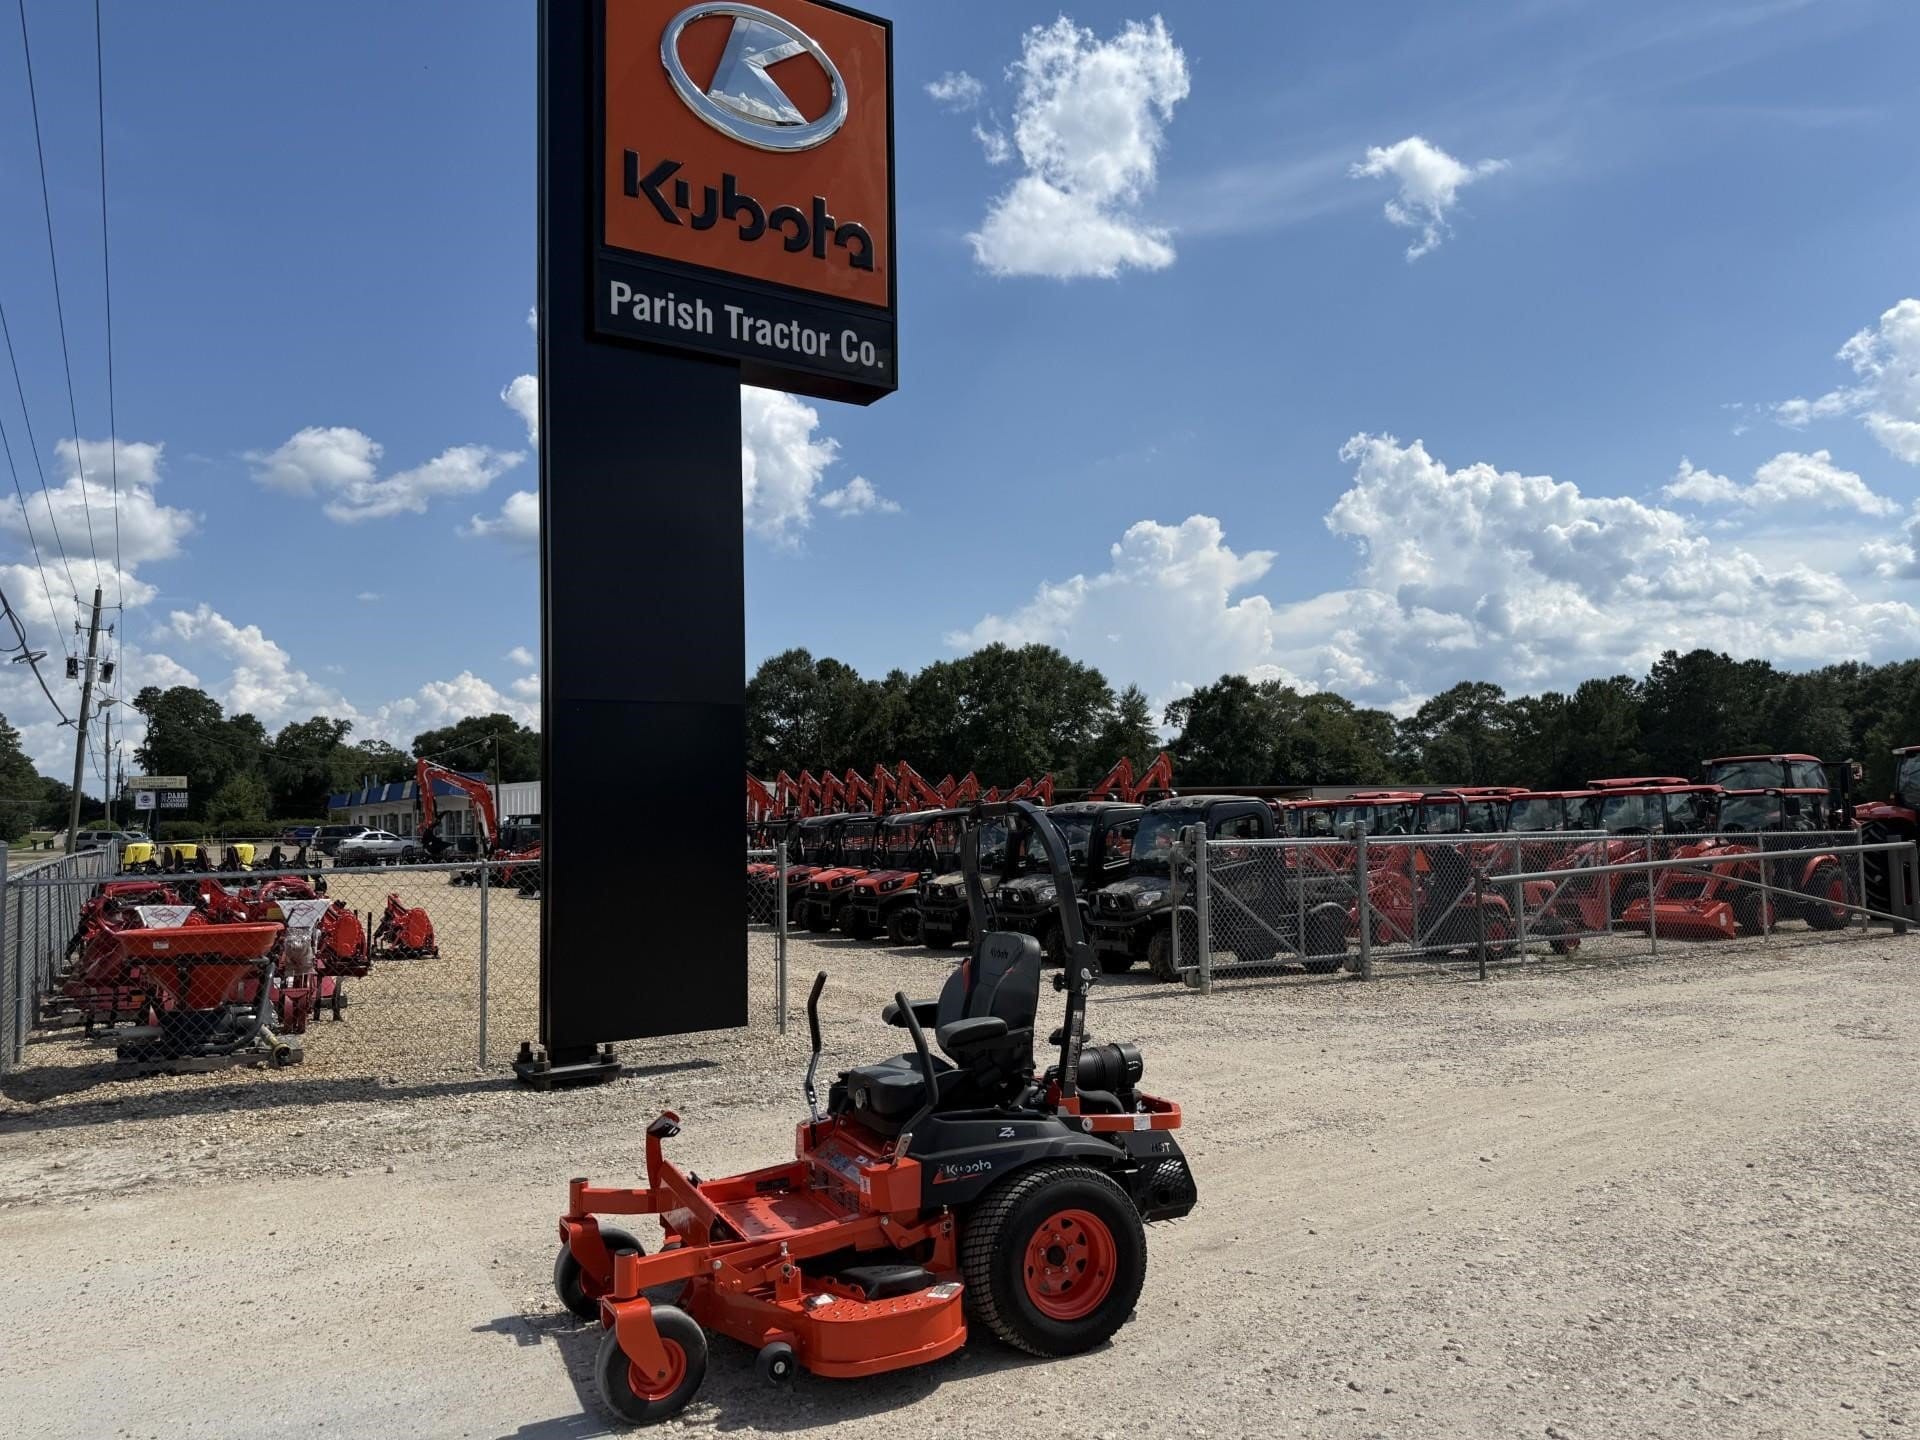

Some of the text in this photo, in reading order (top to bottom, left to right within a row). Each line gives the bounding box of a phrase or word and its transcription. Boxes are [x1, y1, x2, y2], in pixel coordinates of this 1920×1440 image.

[623, 148, 874, 273] Kubota
[609, 280, 884, 368] Parish Tractor Co.
[946, 1160, 992, 1176] Kubota
